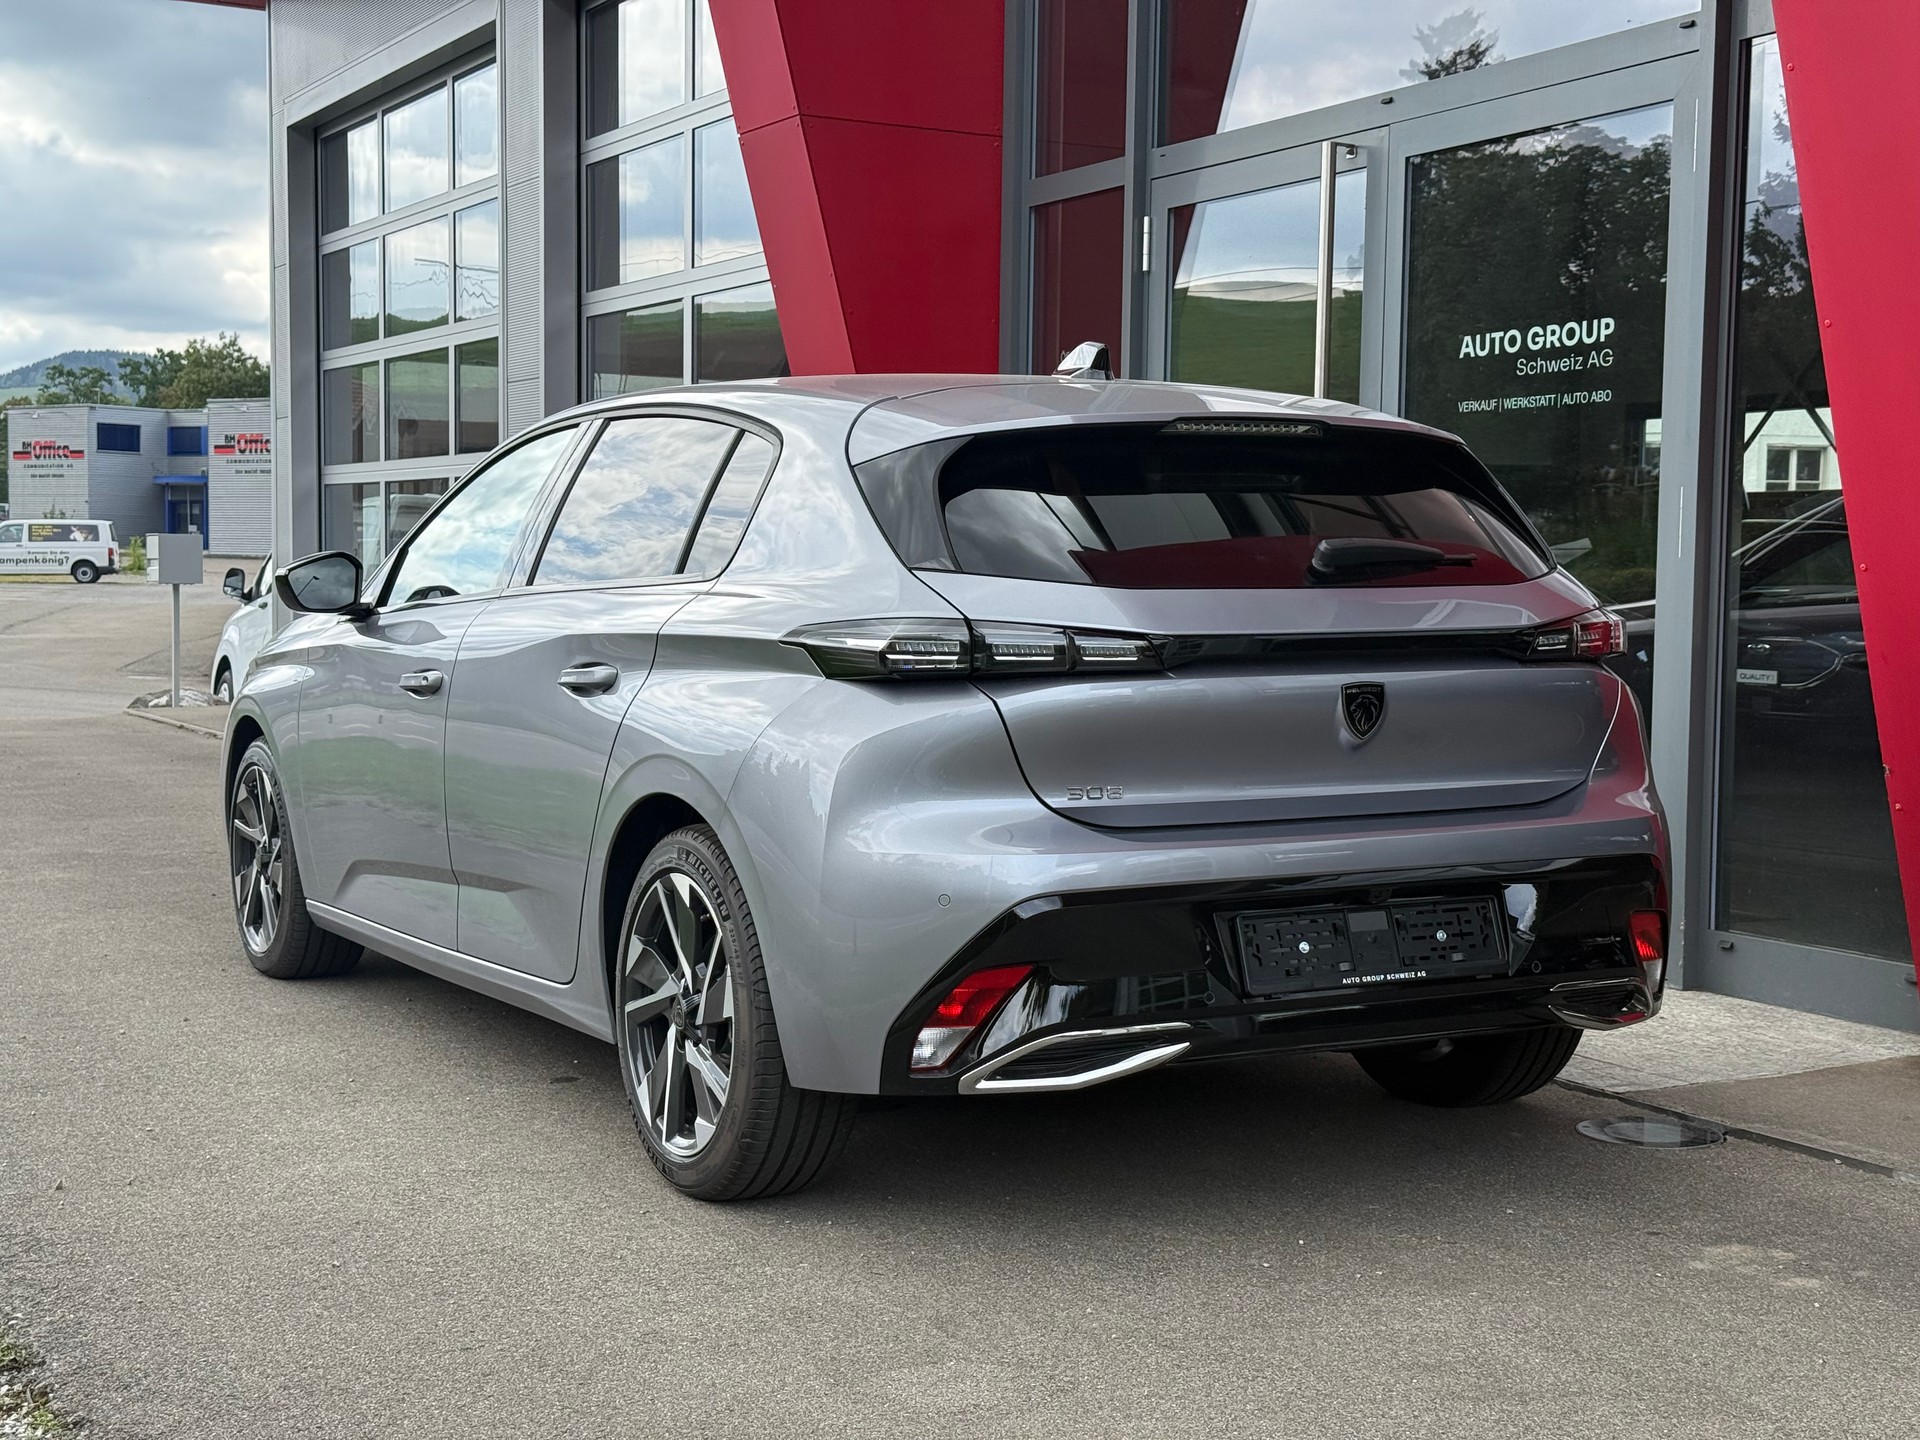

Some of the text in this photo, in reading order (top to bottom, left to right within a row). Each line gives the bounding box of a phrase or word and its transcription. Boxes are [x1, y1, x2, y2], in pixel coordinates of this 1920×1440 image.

[1459, 317, 1615, 359] AUTO GROUP
[1516, 349, 1615, 376] Schweiz AG
[1458, 398, 1498, 413] VERKAUF
[1503, 394, 1557, 410] WERKSTATT
[1562, 391, 1588, 406] AUTO
[1590, 389, 1612, 403] ABO
[33, 440, 70, 459] Office
[237, 433, 271, 454] Offic
[1066, 786, 1123, 801] 308
[687, 853, 729, 917] MICHELIN
[1361, 974, 1385, 982] GROUP
[1386, 971, 1415, 980] SCHWEIZ
